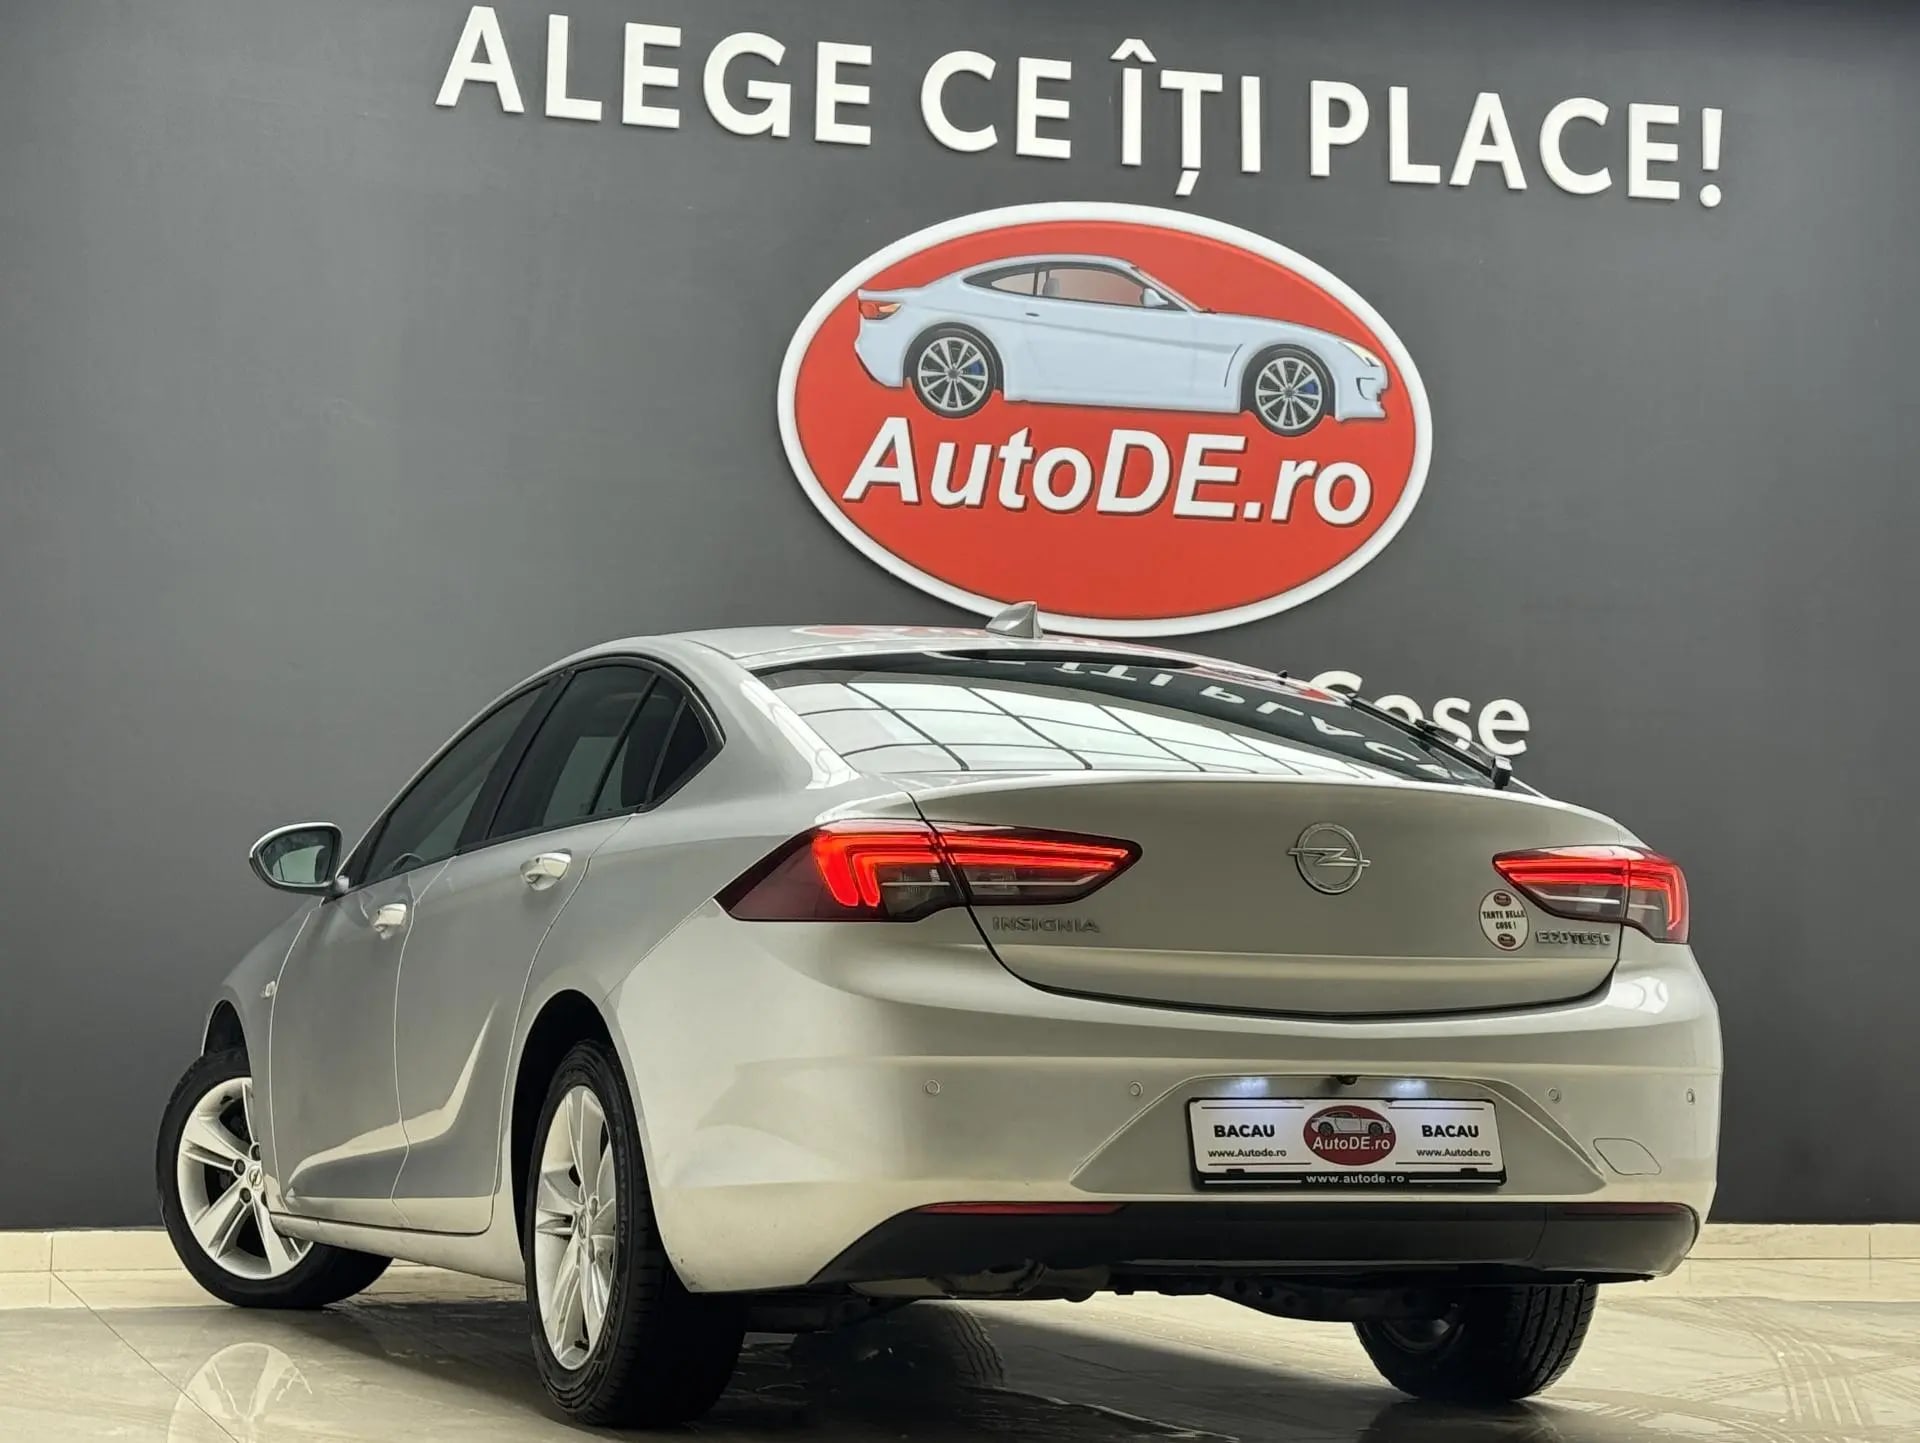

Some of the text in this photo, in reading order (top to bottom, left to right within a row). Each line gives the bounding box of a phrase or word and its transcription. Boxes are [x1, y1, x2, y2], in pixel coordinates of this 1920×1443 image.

[435, 5, 872, 144] ALEGE
[920, 50, 1071, 159] CE
[1310, 80, 1722, 207] PLACE!
[842, 416, 1372, 525] AutoDE.ro
[1482, 909, 1526, 919] TANTE BELLE
[992, 916, 1101, 933] INSIGNIA
[1213, 1124, 1480, 1138] BACAU BACAU
[1312, 1136, 1391, 1150] AutoDE.ro
[1207, 1148, 1492, 1158] www.Autode.ro www.Autode.ro
[1306, 1173, 1406, 1183] www.autode.ro
